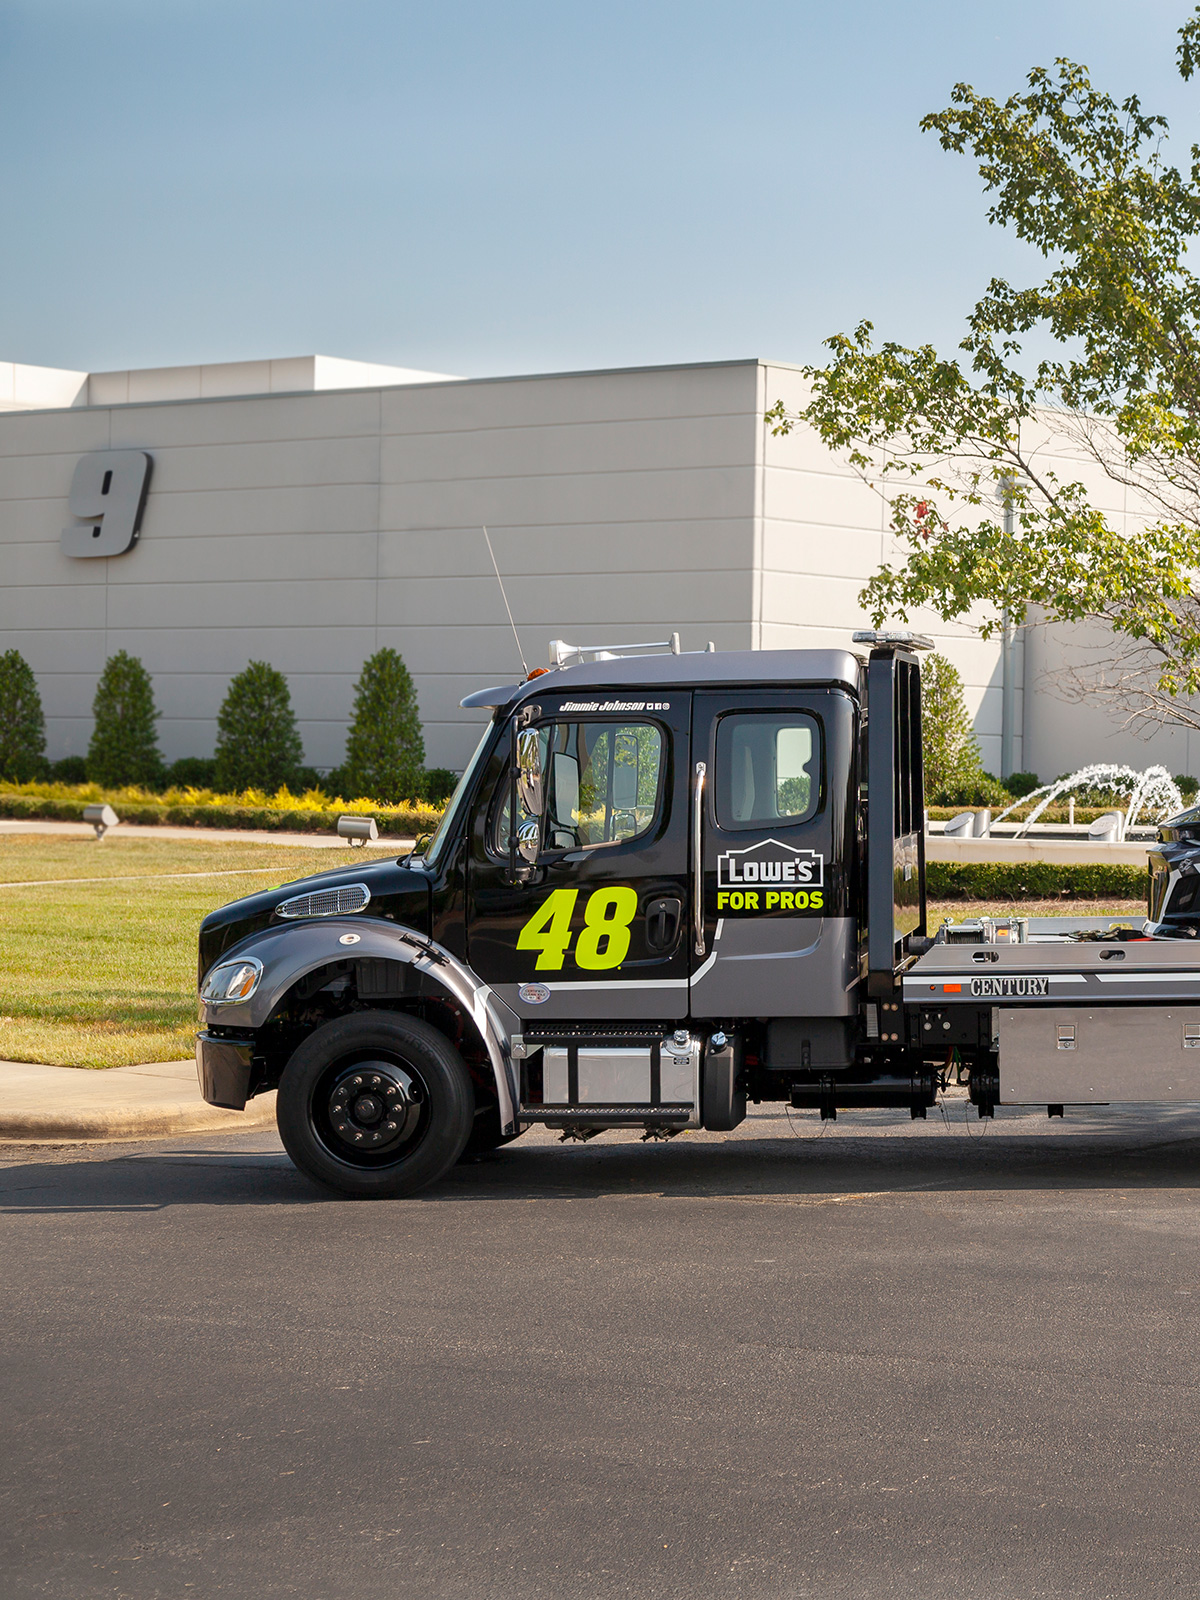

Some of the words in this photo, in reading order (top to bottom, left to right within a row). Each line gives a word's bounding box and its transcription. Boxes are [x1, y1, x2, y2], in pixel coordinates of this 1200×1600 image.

[60, 450, 153, 558] 9
[559, 701, 600, 712] Jimmie
[599, 700, 645, 712] Johnson
[729, 858, 813, 881] LOWE'S
[717, 891, 759, 910] FOR
[765, 891, 824, 910] PROS
[516, 886, 638, 970] 48
[970, 978, 1049, 996] CENTURY
